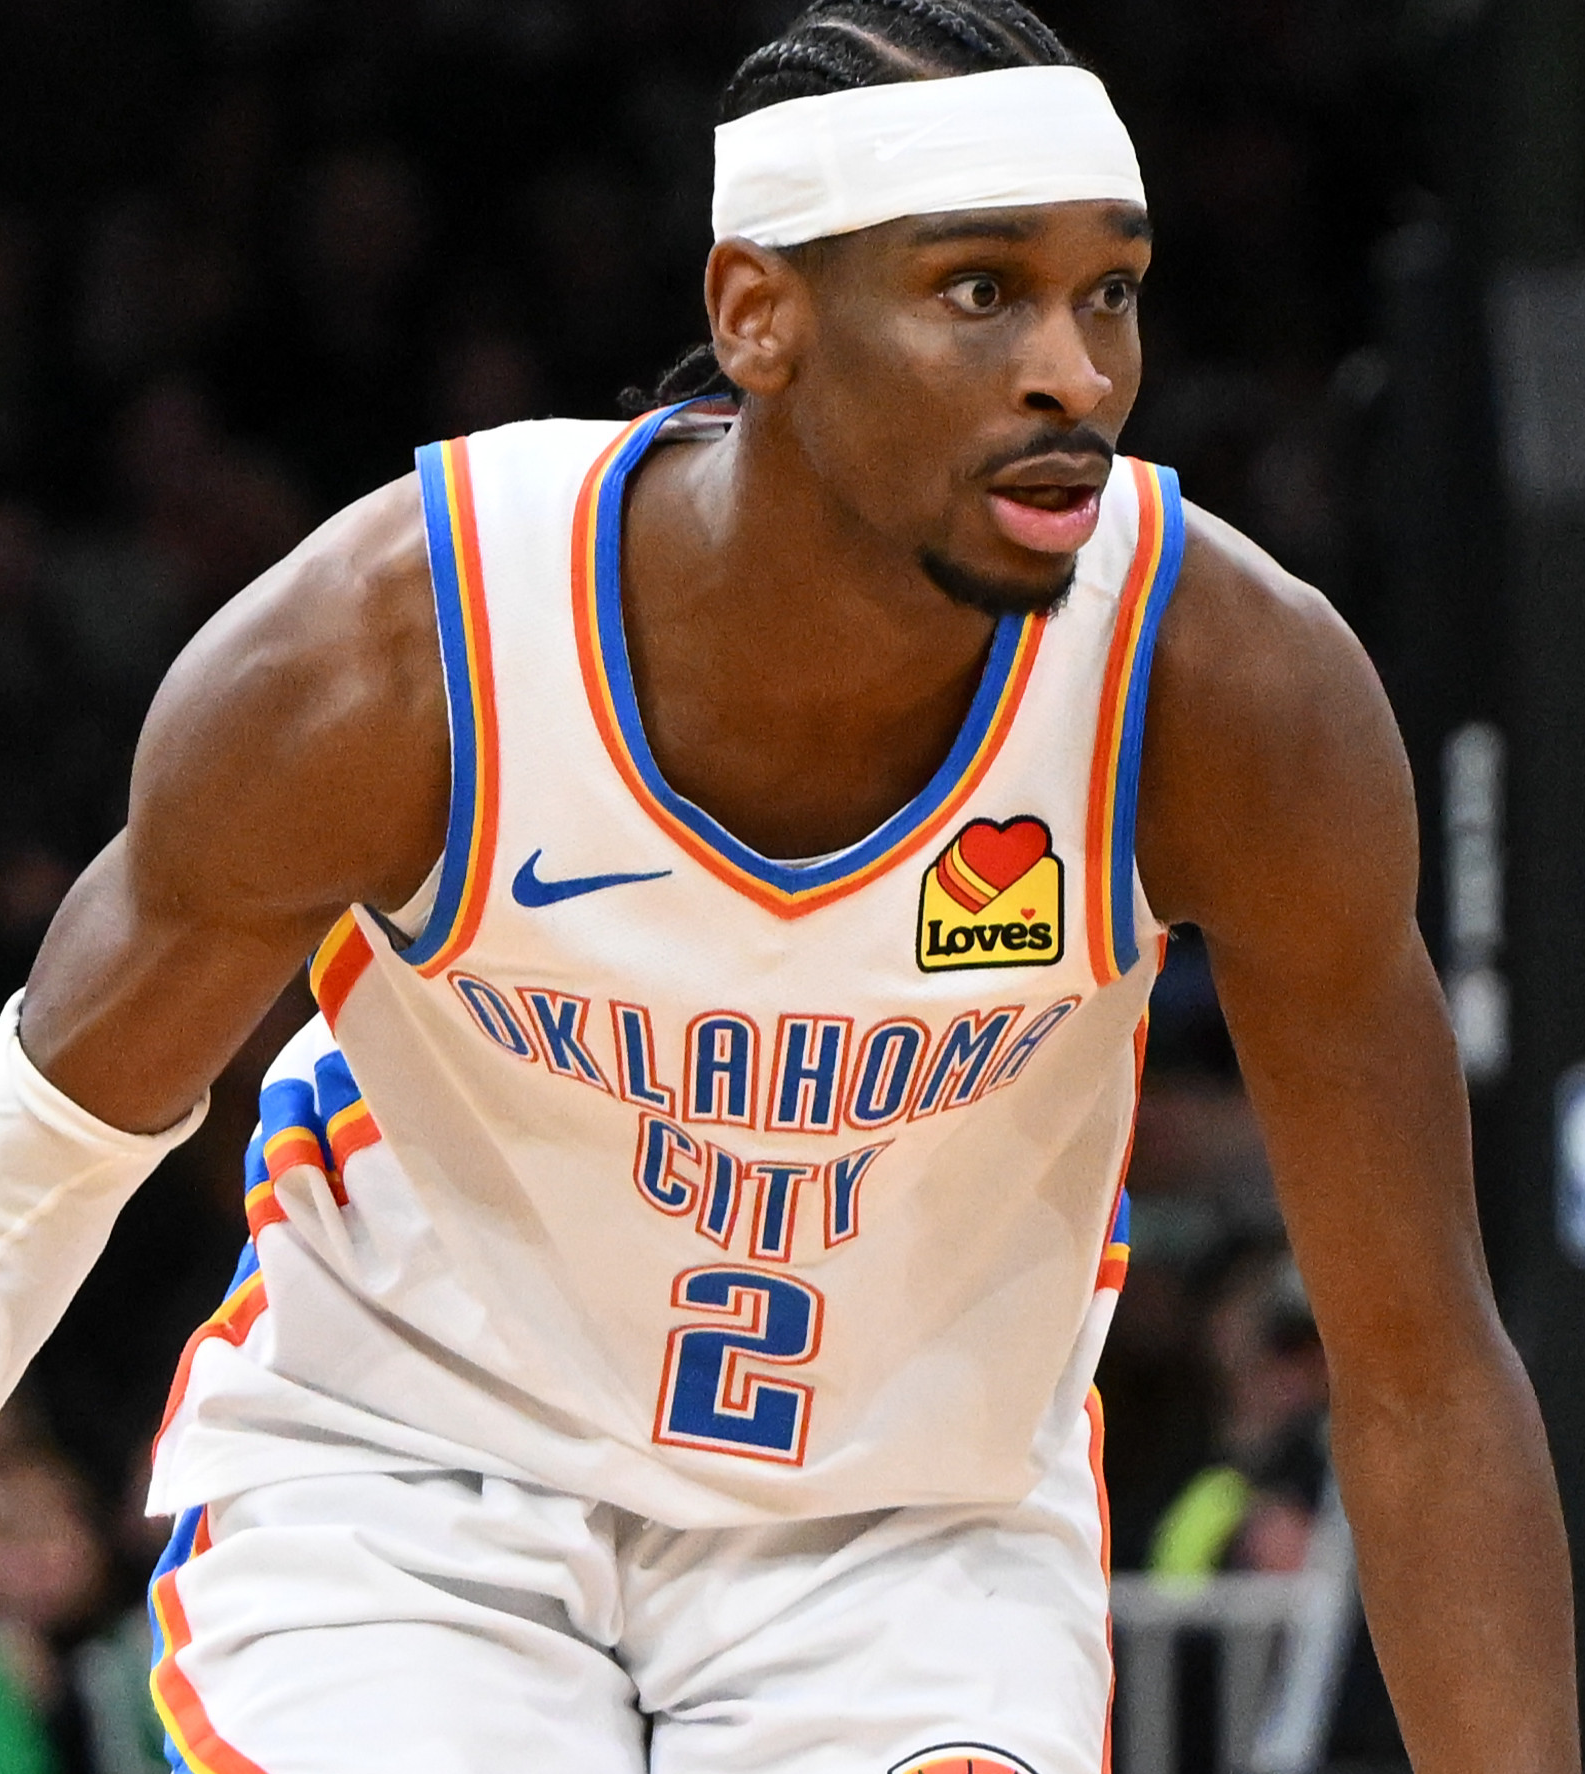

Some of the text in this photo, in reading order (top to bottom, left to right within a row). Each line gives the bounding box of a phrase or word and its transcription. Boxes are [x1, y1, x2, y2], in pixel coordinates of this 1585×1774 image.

[448, 970, 1082, 1136] OKLAHOMA
[633, 1110, 896, 1264] CITY
[651, 1262, 825, 1468] 2
